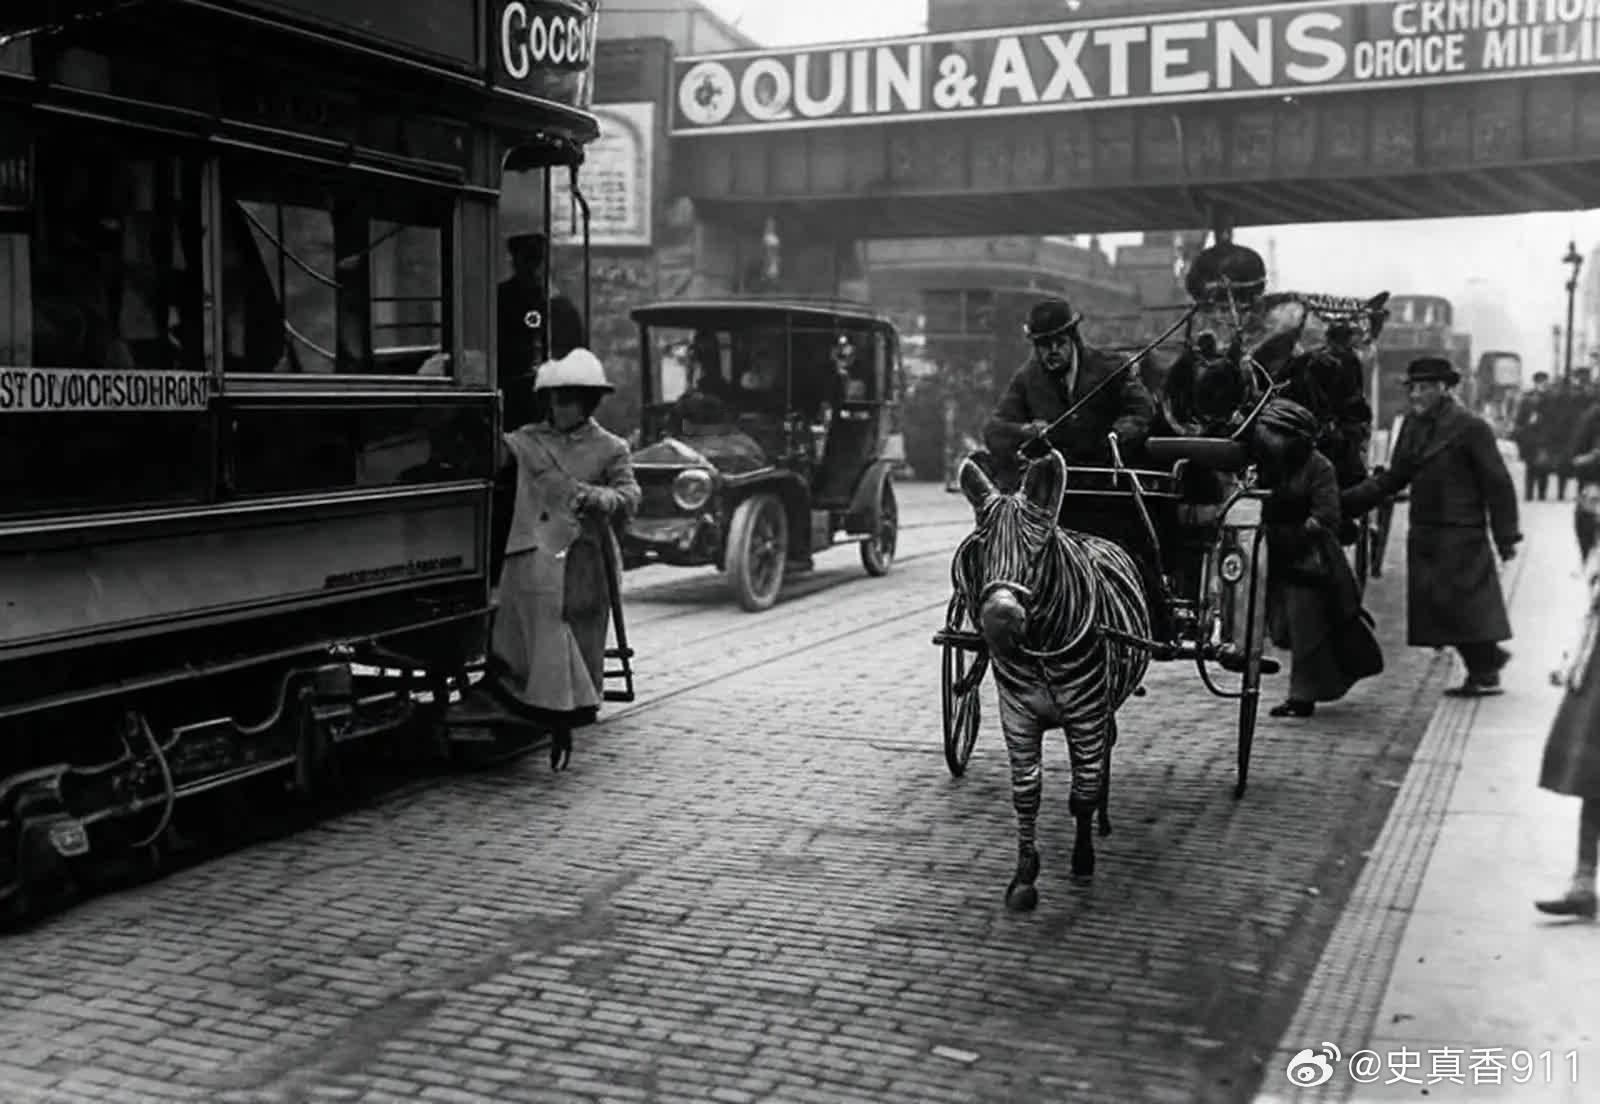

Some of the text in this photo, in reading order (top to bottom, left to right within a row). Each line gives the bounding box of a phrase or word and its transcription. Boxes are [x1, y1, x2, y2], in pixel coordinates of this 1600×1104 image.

[740, 12, 1347, 121] QUIN & AXTENS
